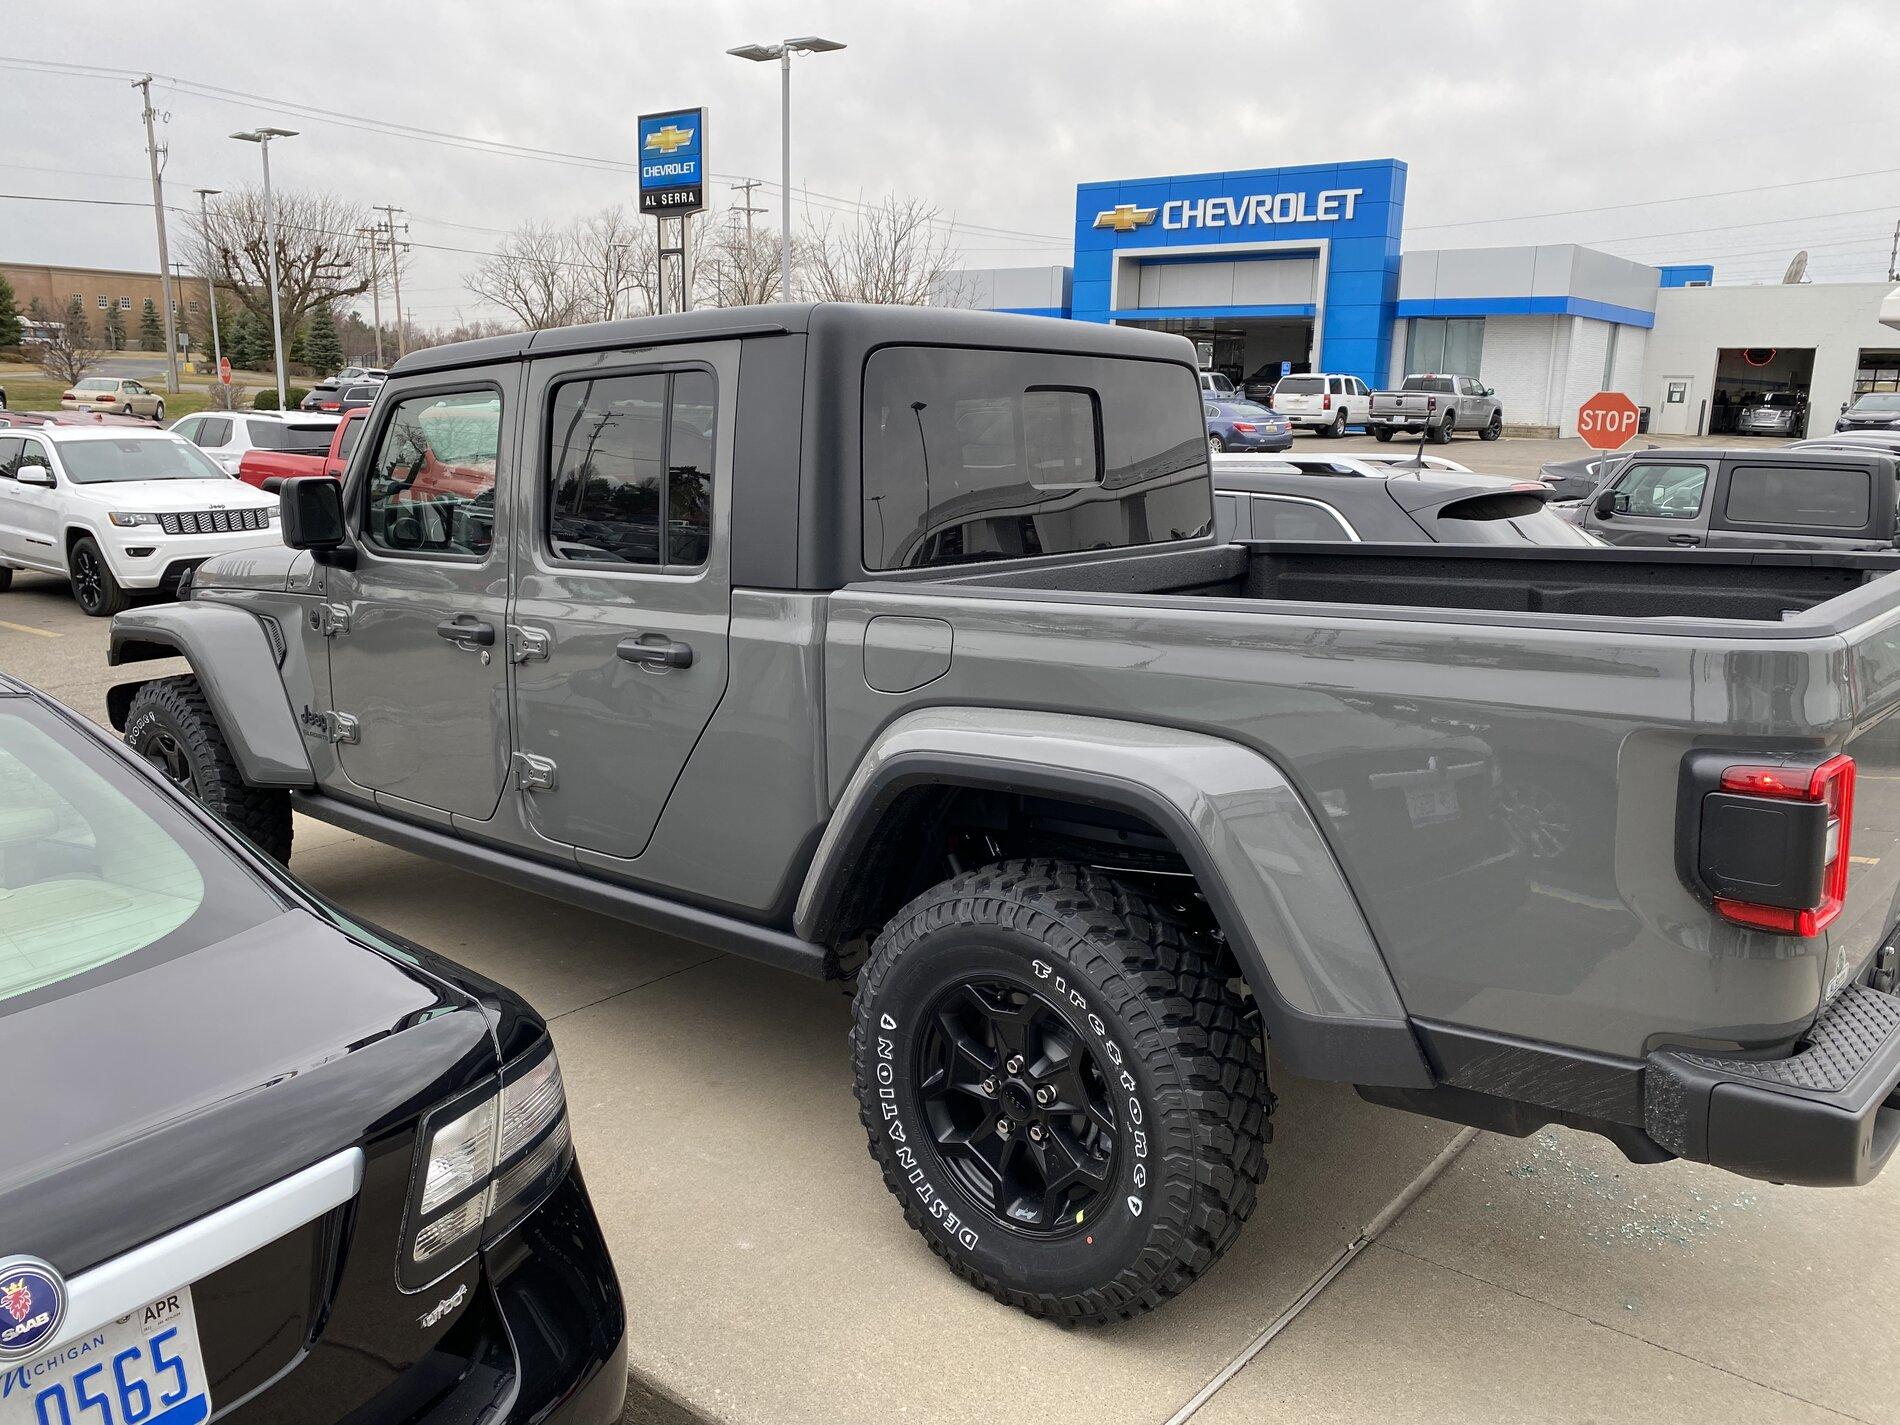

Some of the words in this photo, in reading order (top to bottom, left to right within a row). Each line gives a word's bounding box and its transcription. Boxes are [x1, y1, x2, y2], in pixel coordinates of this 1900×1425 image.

[643, 162, 696, 178] CHEVROLET
[645, 195, 657, 206] AL
[661, 191, 695, 205] SERRA
[1162, 188, 1363, 230] CHEVROLET
[1581, 409, 1636, 432] STOP
[876, 1036, 979, 1251] DESTINATION
[144, 1295, 180, 1324] APR
[1, 1312, 50, 1342] SAAB
[0, 1334, 105, 1398] MICHIGAN
